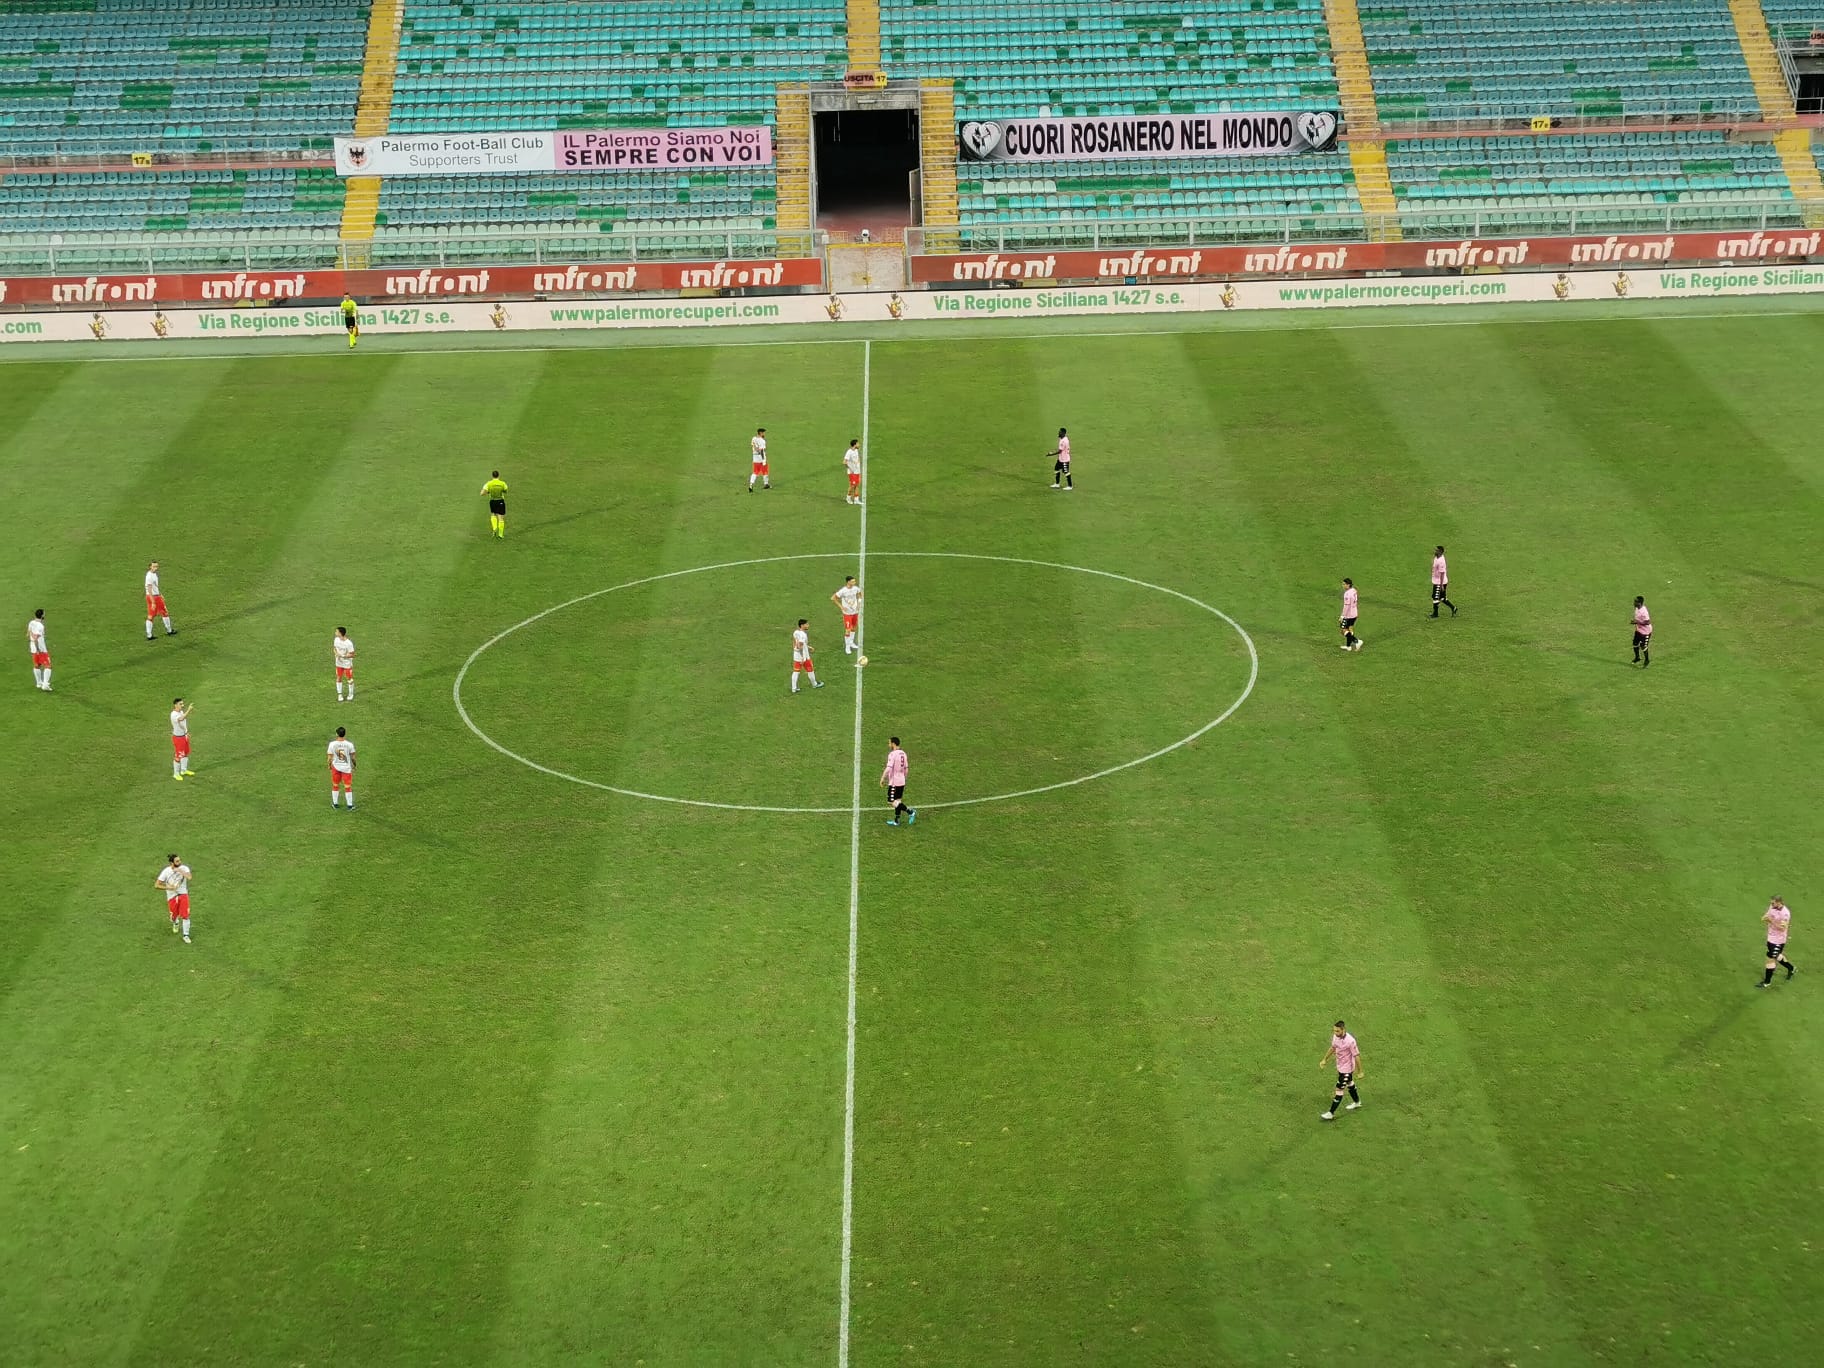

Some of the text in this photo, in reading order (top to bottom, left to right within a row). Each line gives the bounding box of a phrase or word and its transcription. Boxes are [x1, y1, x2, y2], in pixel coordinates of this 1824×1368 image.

[844, 74, 875, 82] USCITA
[381, 136, 544, 152] Palermo Foot-Ball Club
[563, 129, 760, 148] IL Palermo Siamo Noi
[1005, 116, 1293, 156] CUORI ROSANERO NEL MONDO
[409, 152, 519, 169] Supporters Trust
[565, 145, 761, 166] SEMPRE CON VOI
[1425, 240, 1529, 267] infront
[1571, 236, 1675, 262] infront
[1717, 232, 1821, 258] infront
[953, 254, 1056, 280] infront
[1099, 250, 1202, 276] infront
[1244, 246, 1348, 272] infront
[201, 273, 306, 299] infront
[386, 269, 490, 295] infront
[533, 265, 637, 291] infront
[680, 262, 784, 288] infront
[1660, 272, 1686, 290] Via
[1690, 271, 1758, 292] Regione
[52, 276, 157, 302] infront
[933, 288, 1185, 313] Via Regione Siciliana 1427 s.e.
[199, 308, 455, 332] Via Regione Sicilina 1427 s.e.
